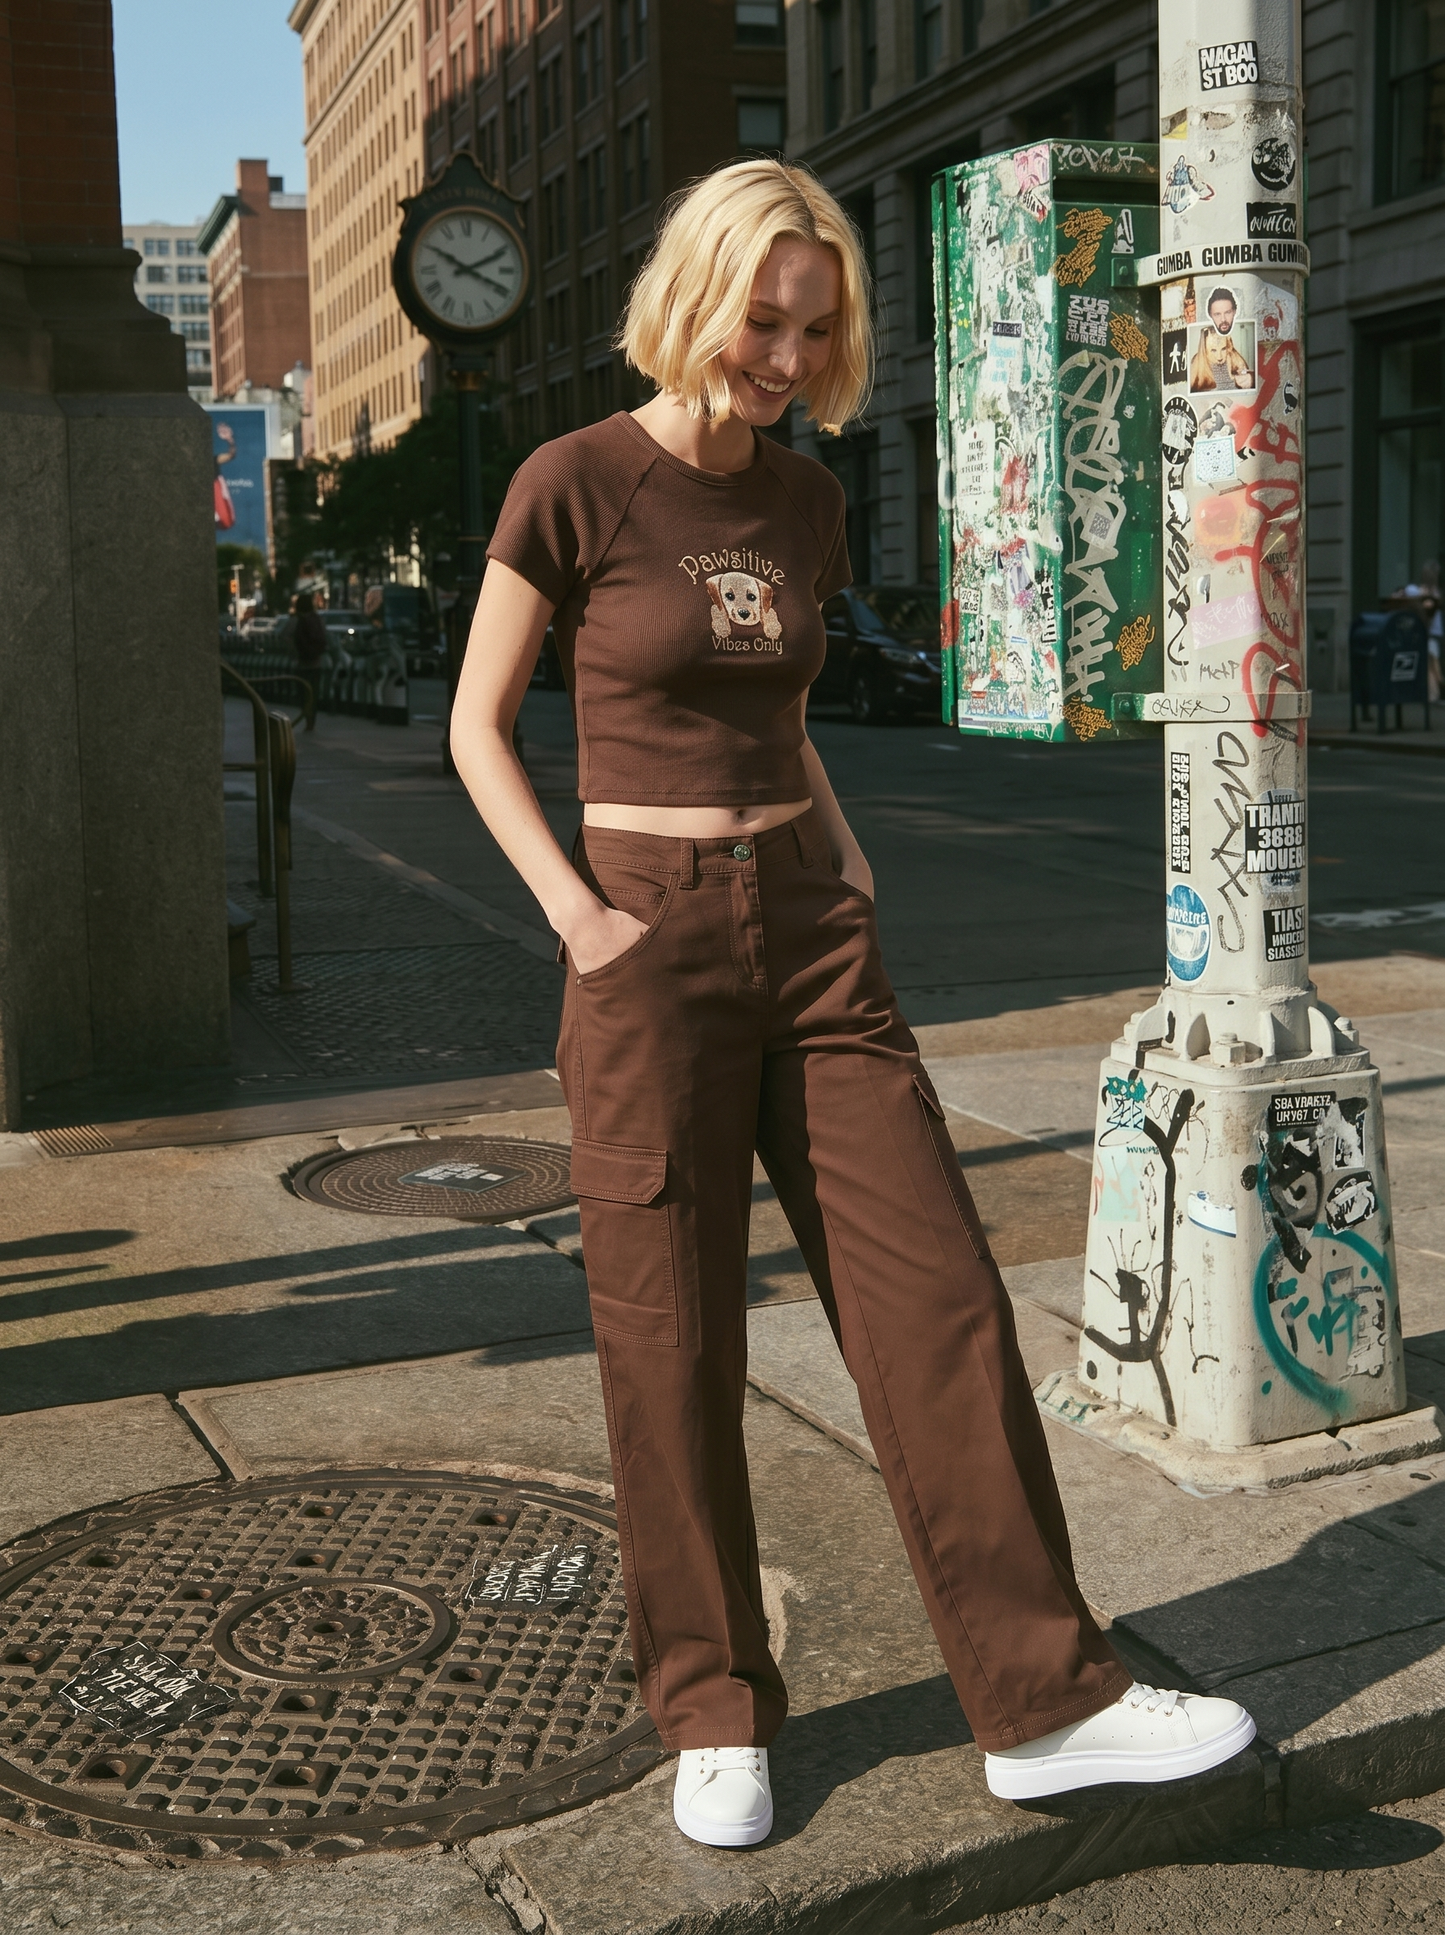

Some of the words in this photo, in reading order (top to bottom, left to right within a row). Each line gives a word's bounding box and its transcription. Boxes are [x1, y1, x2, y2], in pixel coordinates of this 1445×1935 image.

[1202, 67, 1222, 89] ST
[1225, 62, 1258, 85] BOO
[1157, 250, 1193, 276] GUMBA
[1202, 243, 1263, 267] GUMBA
[678, 547, 786, 585] Pawsitive
[711, 635, 750, 651] Vibes
[753, 637, 784, 655] Only
